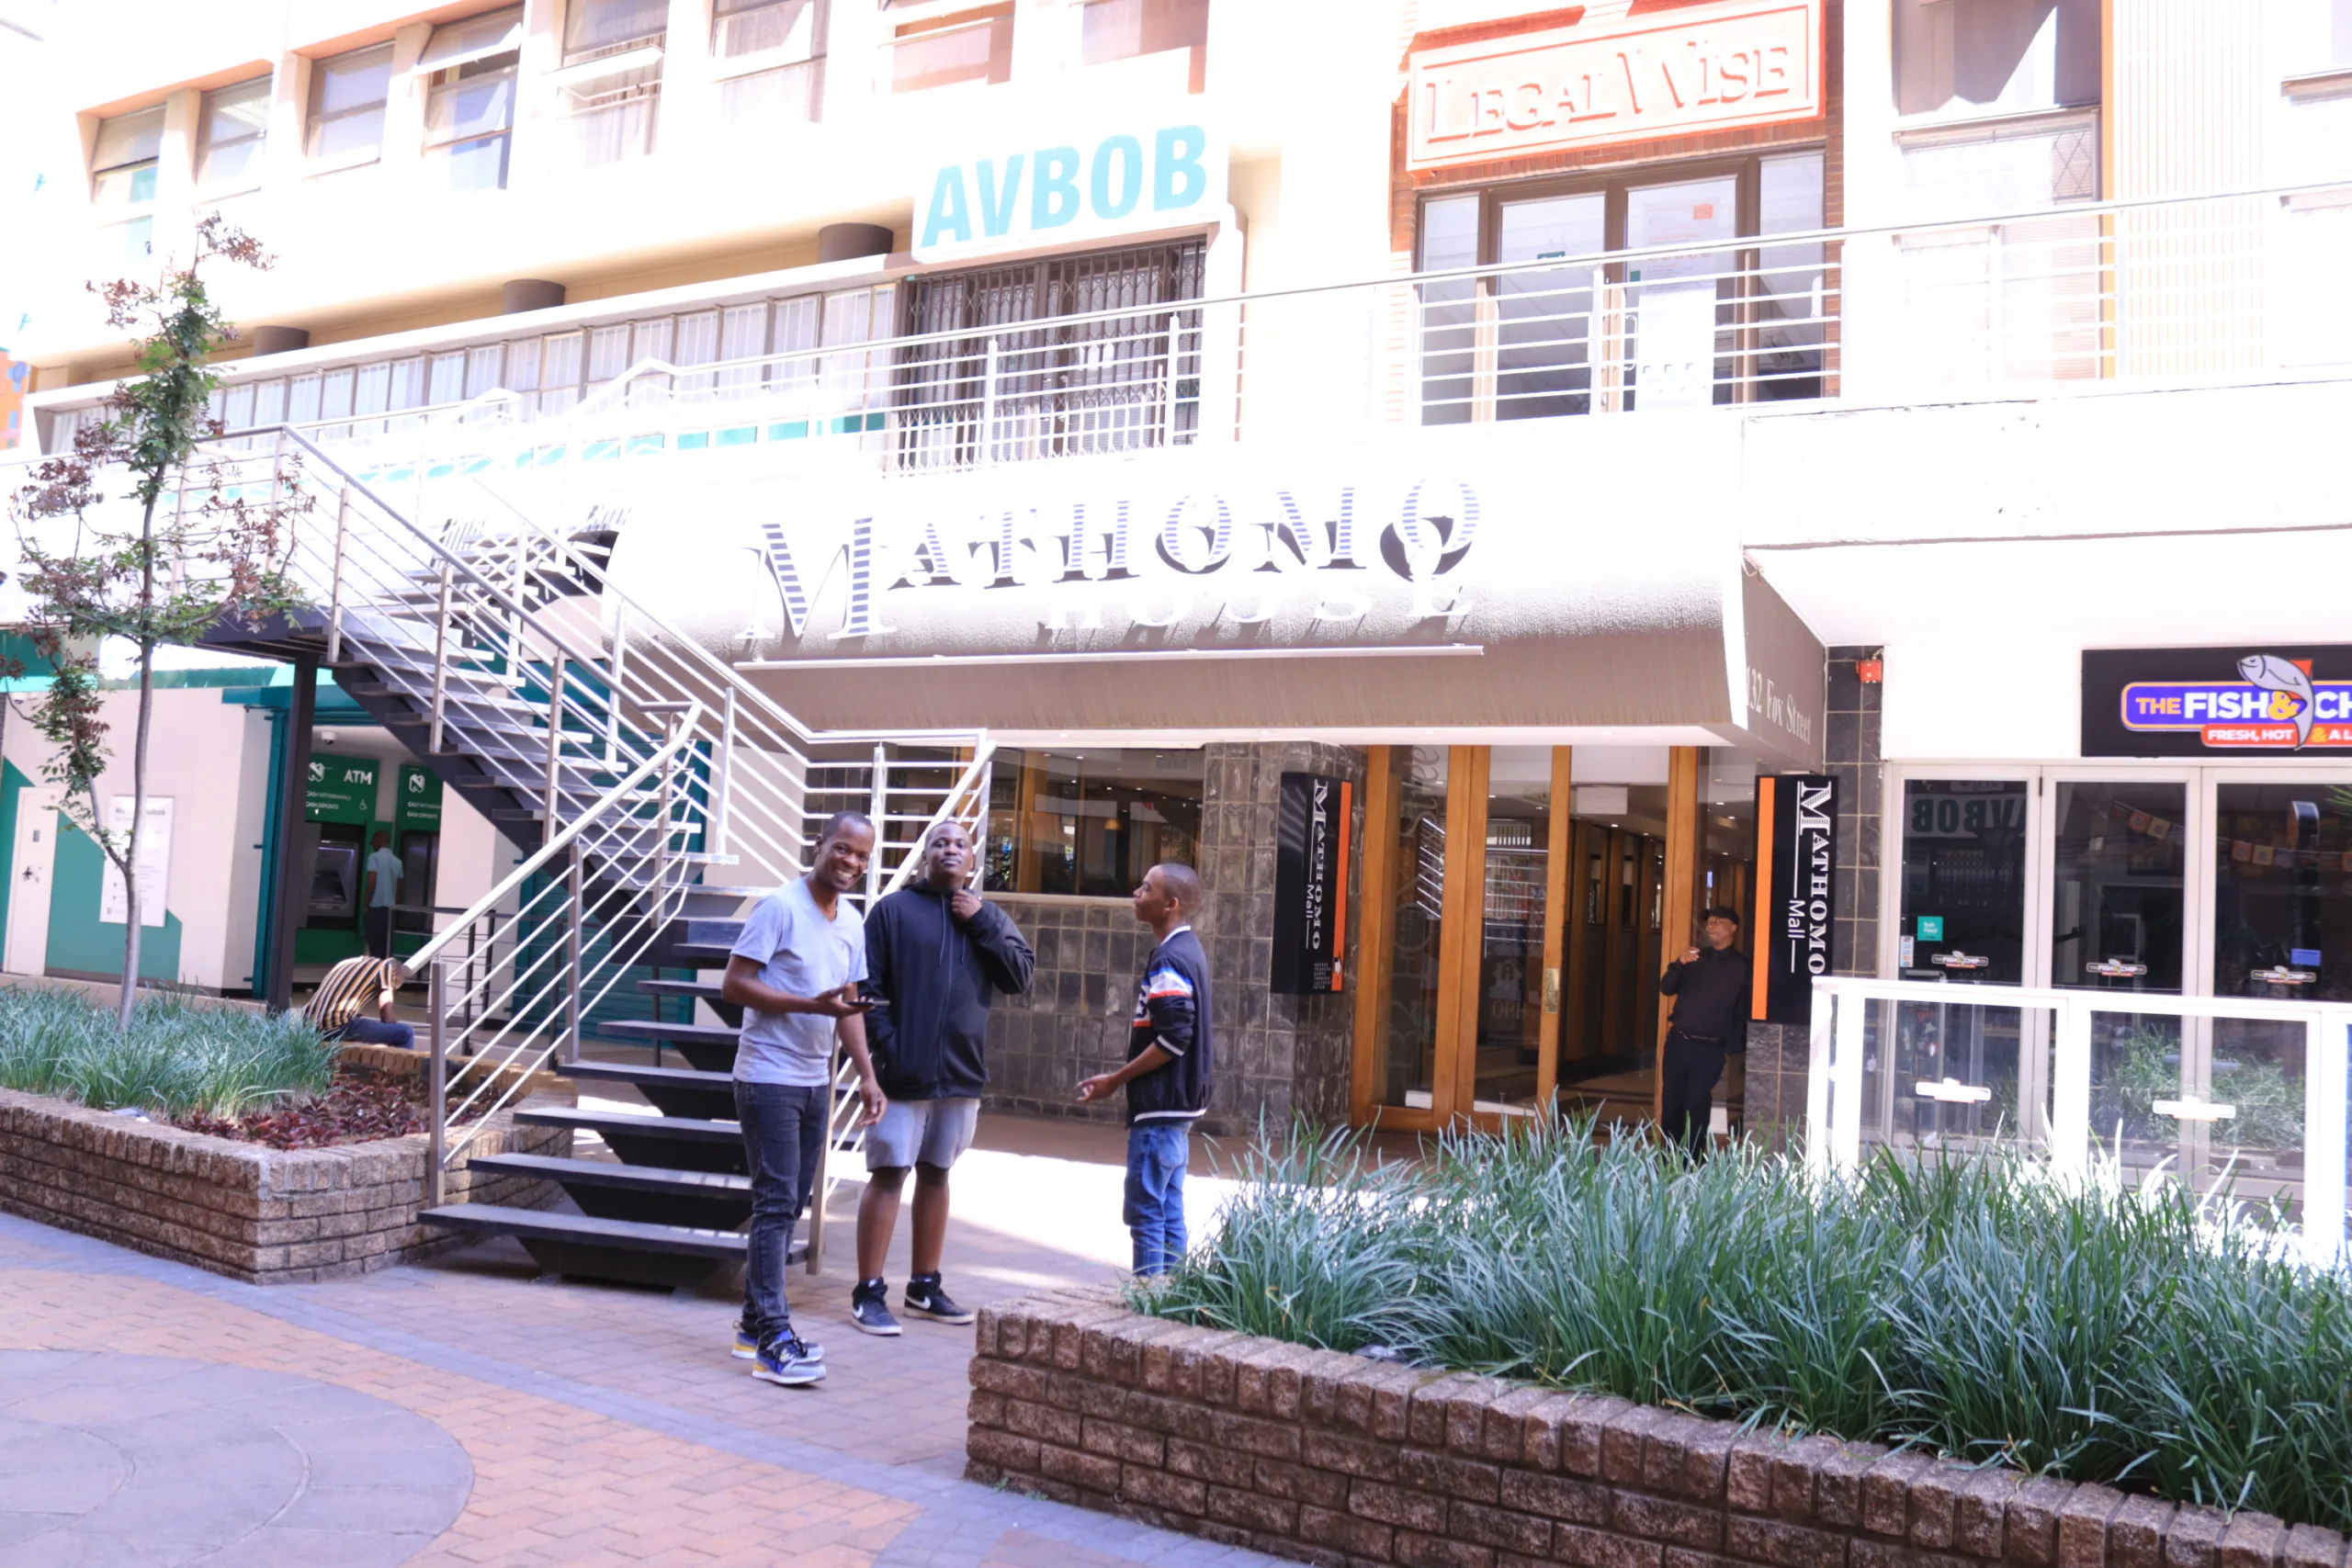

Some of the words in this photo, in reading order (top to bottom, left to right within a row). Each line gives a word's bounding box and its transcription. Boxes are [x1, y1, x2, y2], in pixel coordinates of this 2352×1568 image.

[921, 125, 1206, 247] AVBOB
[735, 478, 1481, 639] MATHOMO
[1045, 571, 1474, 629] HOUSE
[1747, 666, 1763, 714] 132
[1767, 678, 1784, 726] Fox
[1786, 694, 1812, 745] Street
[2136, 697, 2182, 715] THE
[2208, 728, 2260, 742] FRESH,
[2261, 728, 2294, 740] HOT
[2311, 727, 2328, 742] &
[344, 769, 372, 785] ATM
[1399, 745, 1442, 837] Stree
[1312, 779, 1329, 950] MATHOMO
[1800, 781, 1832, 975] MATHOMO
[1306, 884, 1315, 919] Mall
[1788, 898, 1805, 939] Mall
